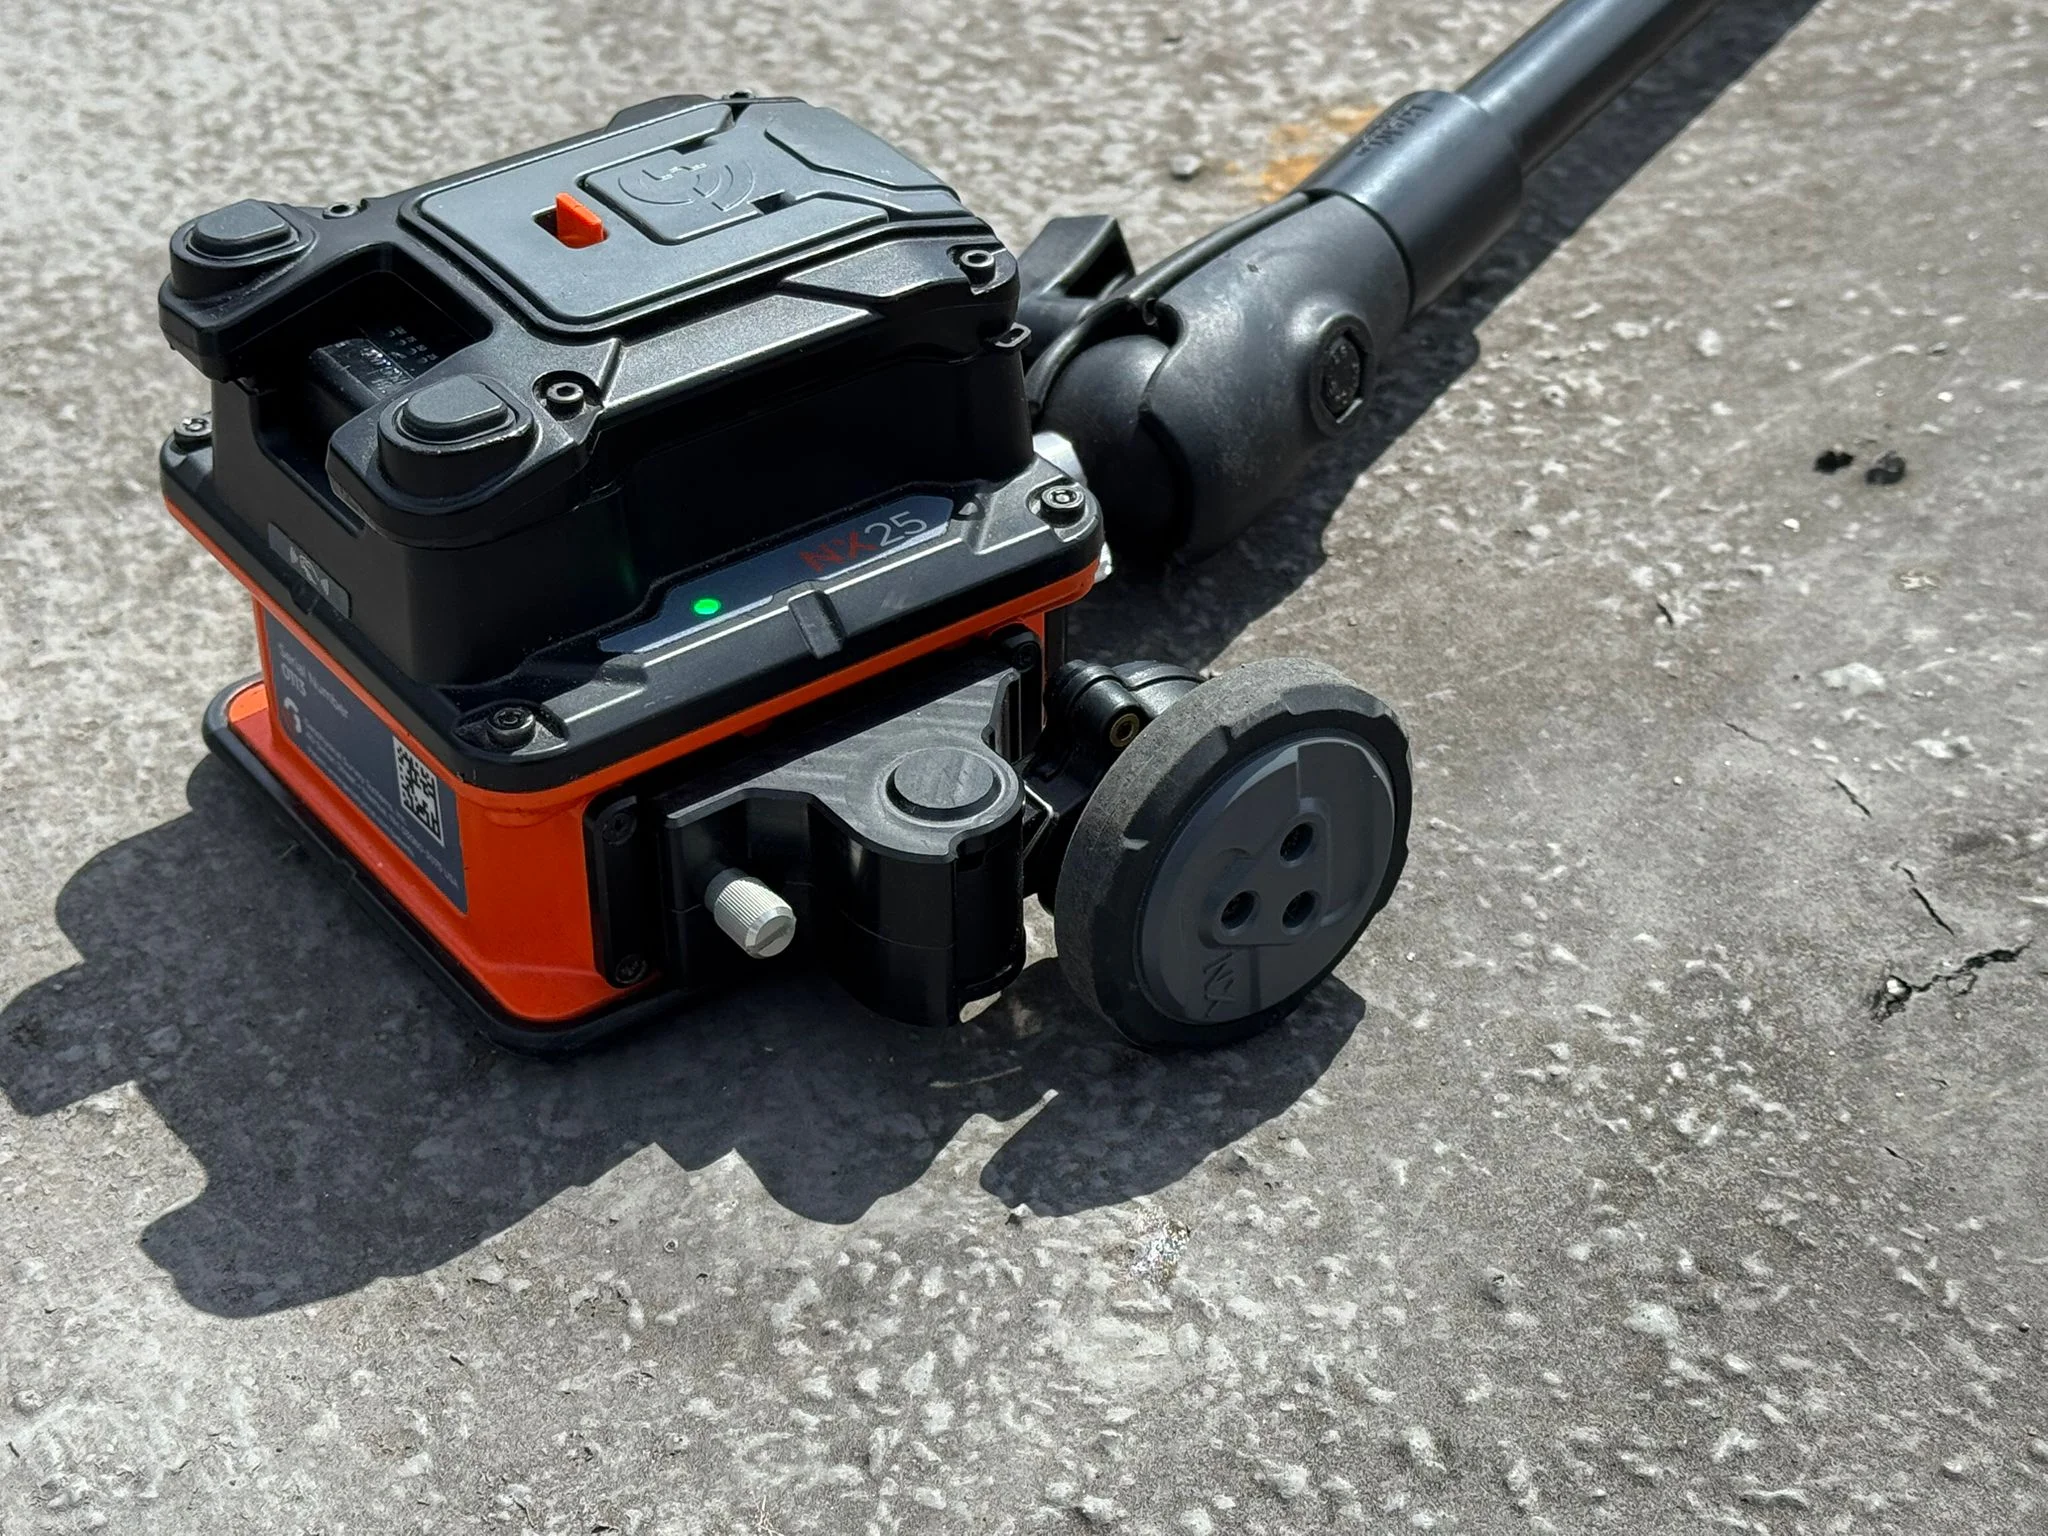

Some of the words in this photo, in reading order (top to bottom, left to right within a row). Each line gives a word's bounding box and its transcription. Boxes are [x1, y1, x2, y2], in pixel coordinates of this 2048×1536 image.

[799, 510, 928, 573] NX25
[278, 643, 307, 678] Serial
[308, 672, 349, 719] Number
